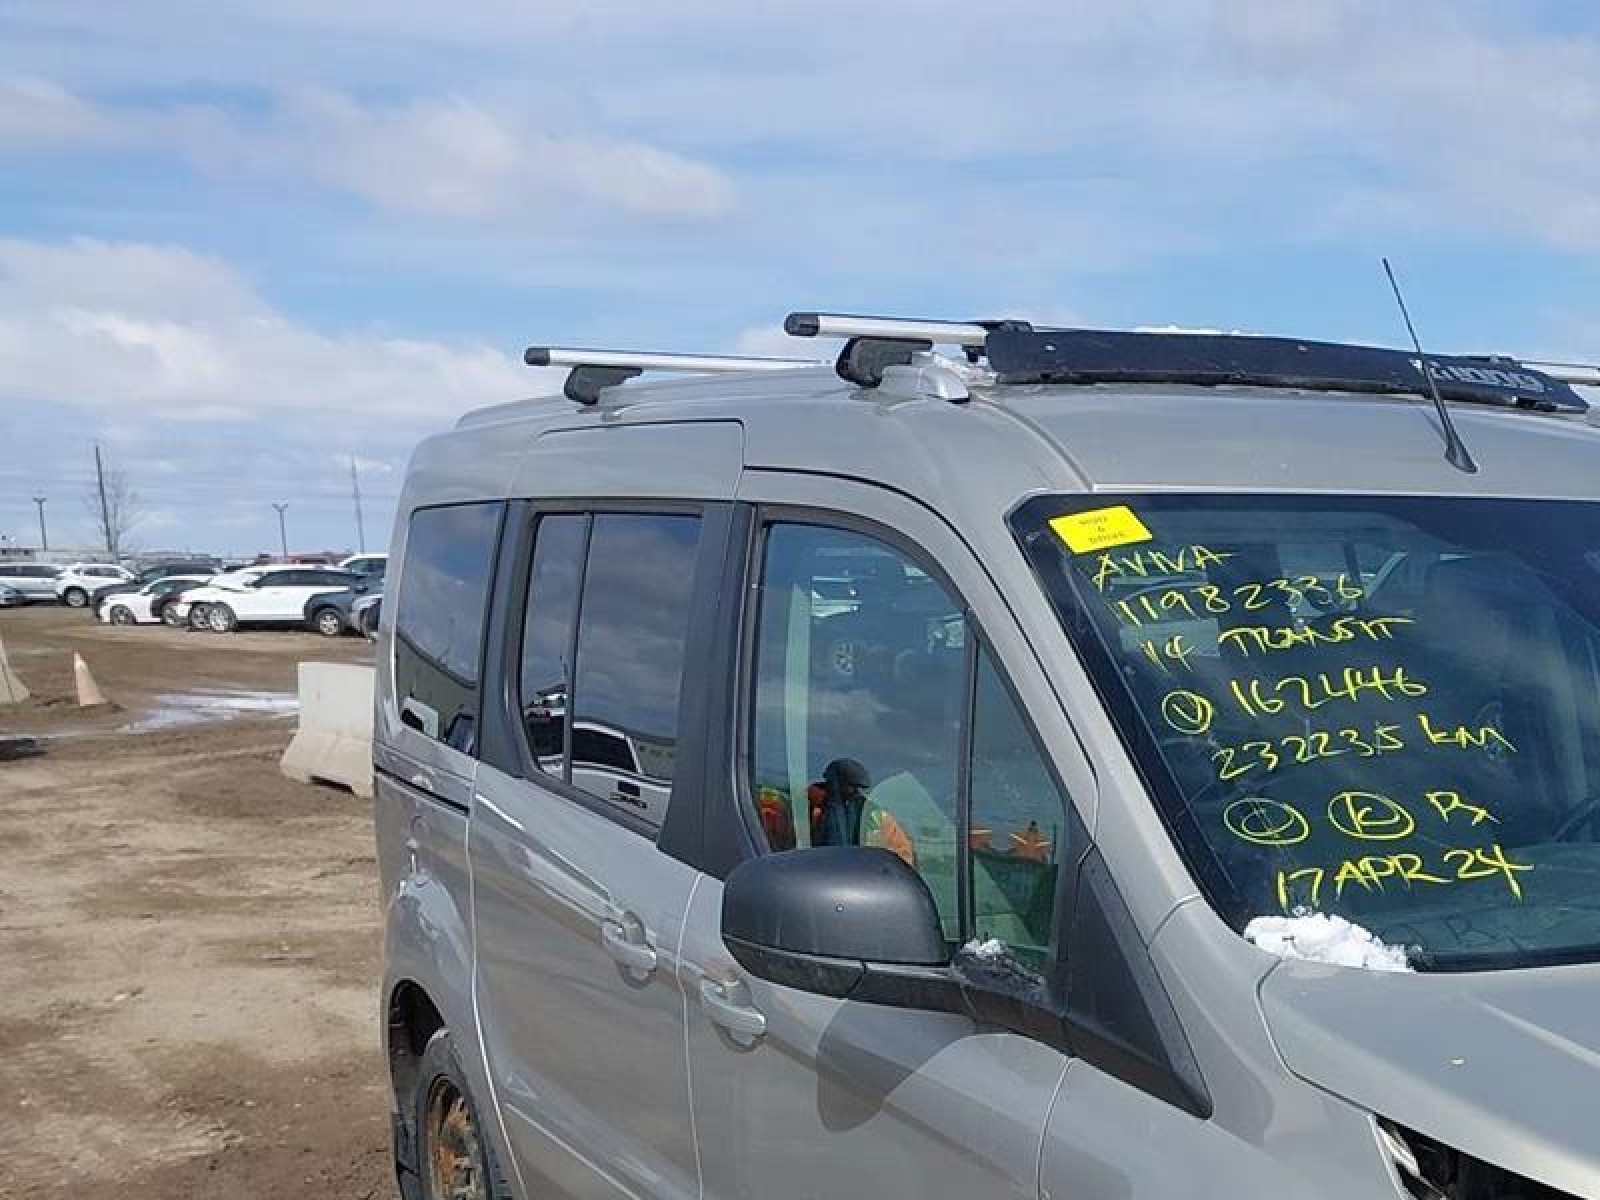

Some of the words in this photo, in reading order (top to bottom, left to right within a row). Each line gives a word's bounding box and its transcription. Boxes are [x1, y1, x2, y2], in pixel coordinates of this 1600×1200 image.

[1092, 545, 1232, 592] AVIVA
[1118, 573, 1363, 627] 11982336
[1231, 667, 1427, 717] 162446
[1212, 727, 1404, 780] 232235
[1277, 866, 1324, 910] 17
[1334, 853, 1453, 900] APR
[1444, 844, 1535, 900] 24
